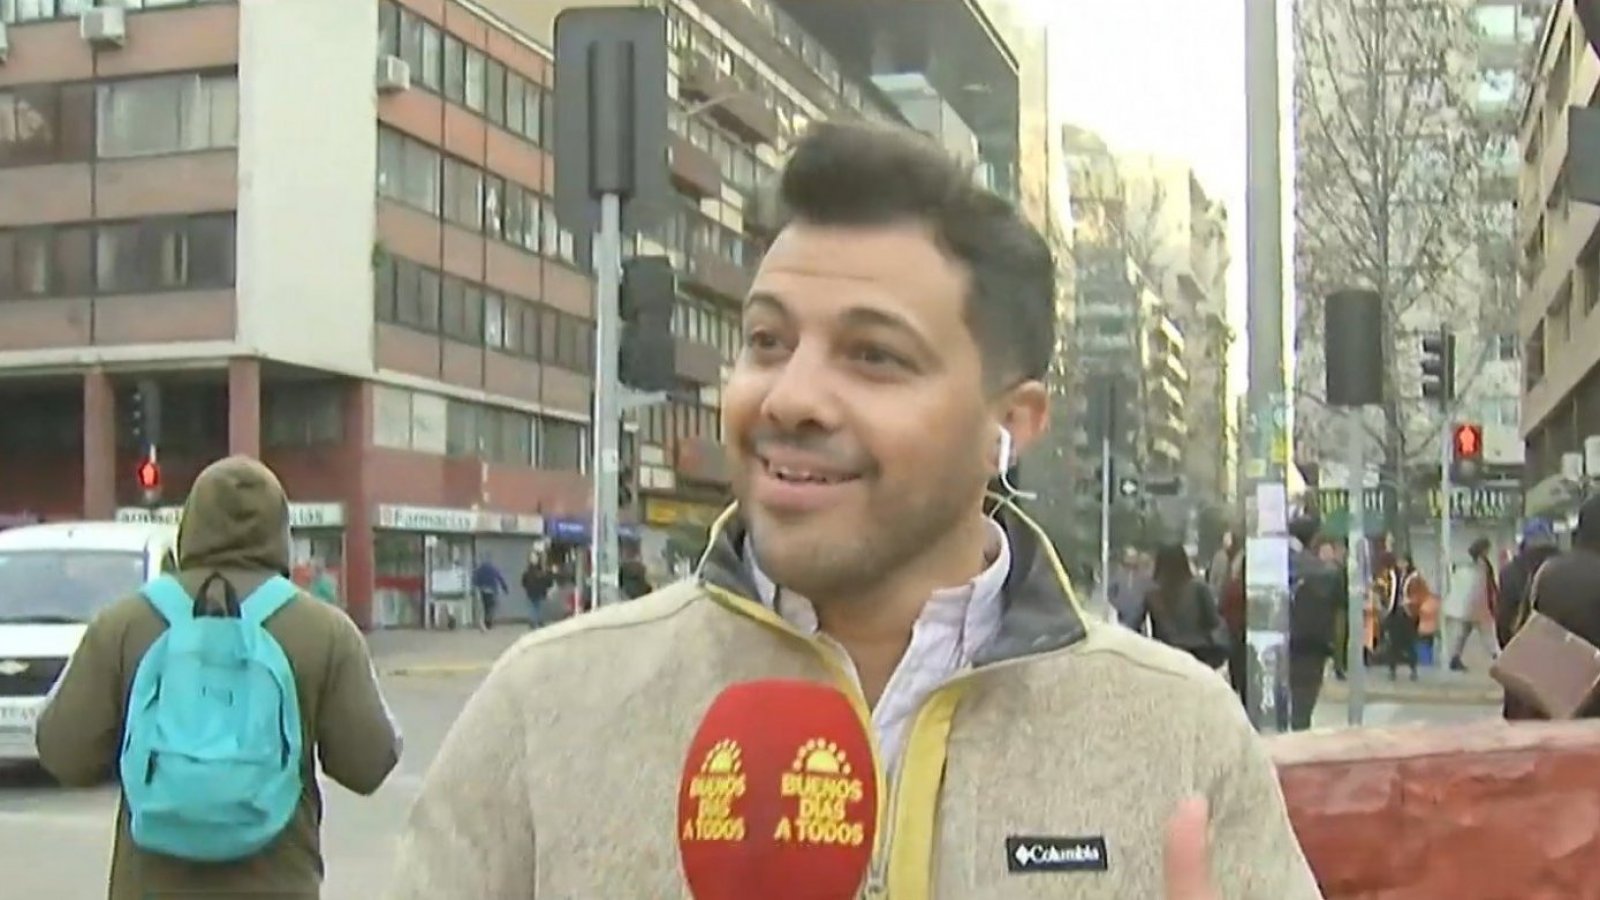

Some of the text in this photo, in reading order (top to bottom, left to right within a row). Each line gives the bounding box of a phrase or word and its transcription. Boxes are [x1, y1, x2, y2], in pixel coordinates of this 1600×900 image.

[393, 507, 472, 529] Farmacias
[781, 772, 863, 802] BUENOS
[683, 817, 745, 841] A TODOS
[774, 816, 864, 846] A TODOS
[1030, 844, 1100, 864] Columbia
